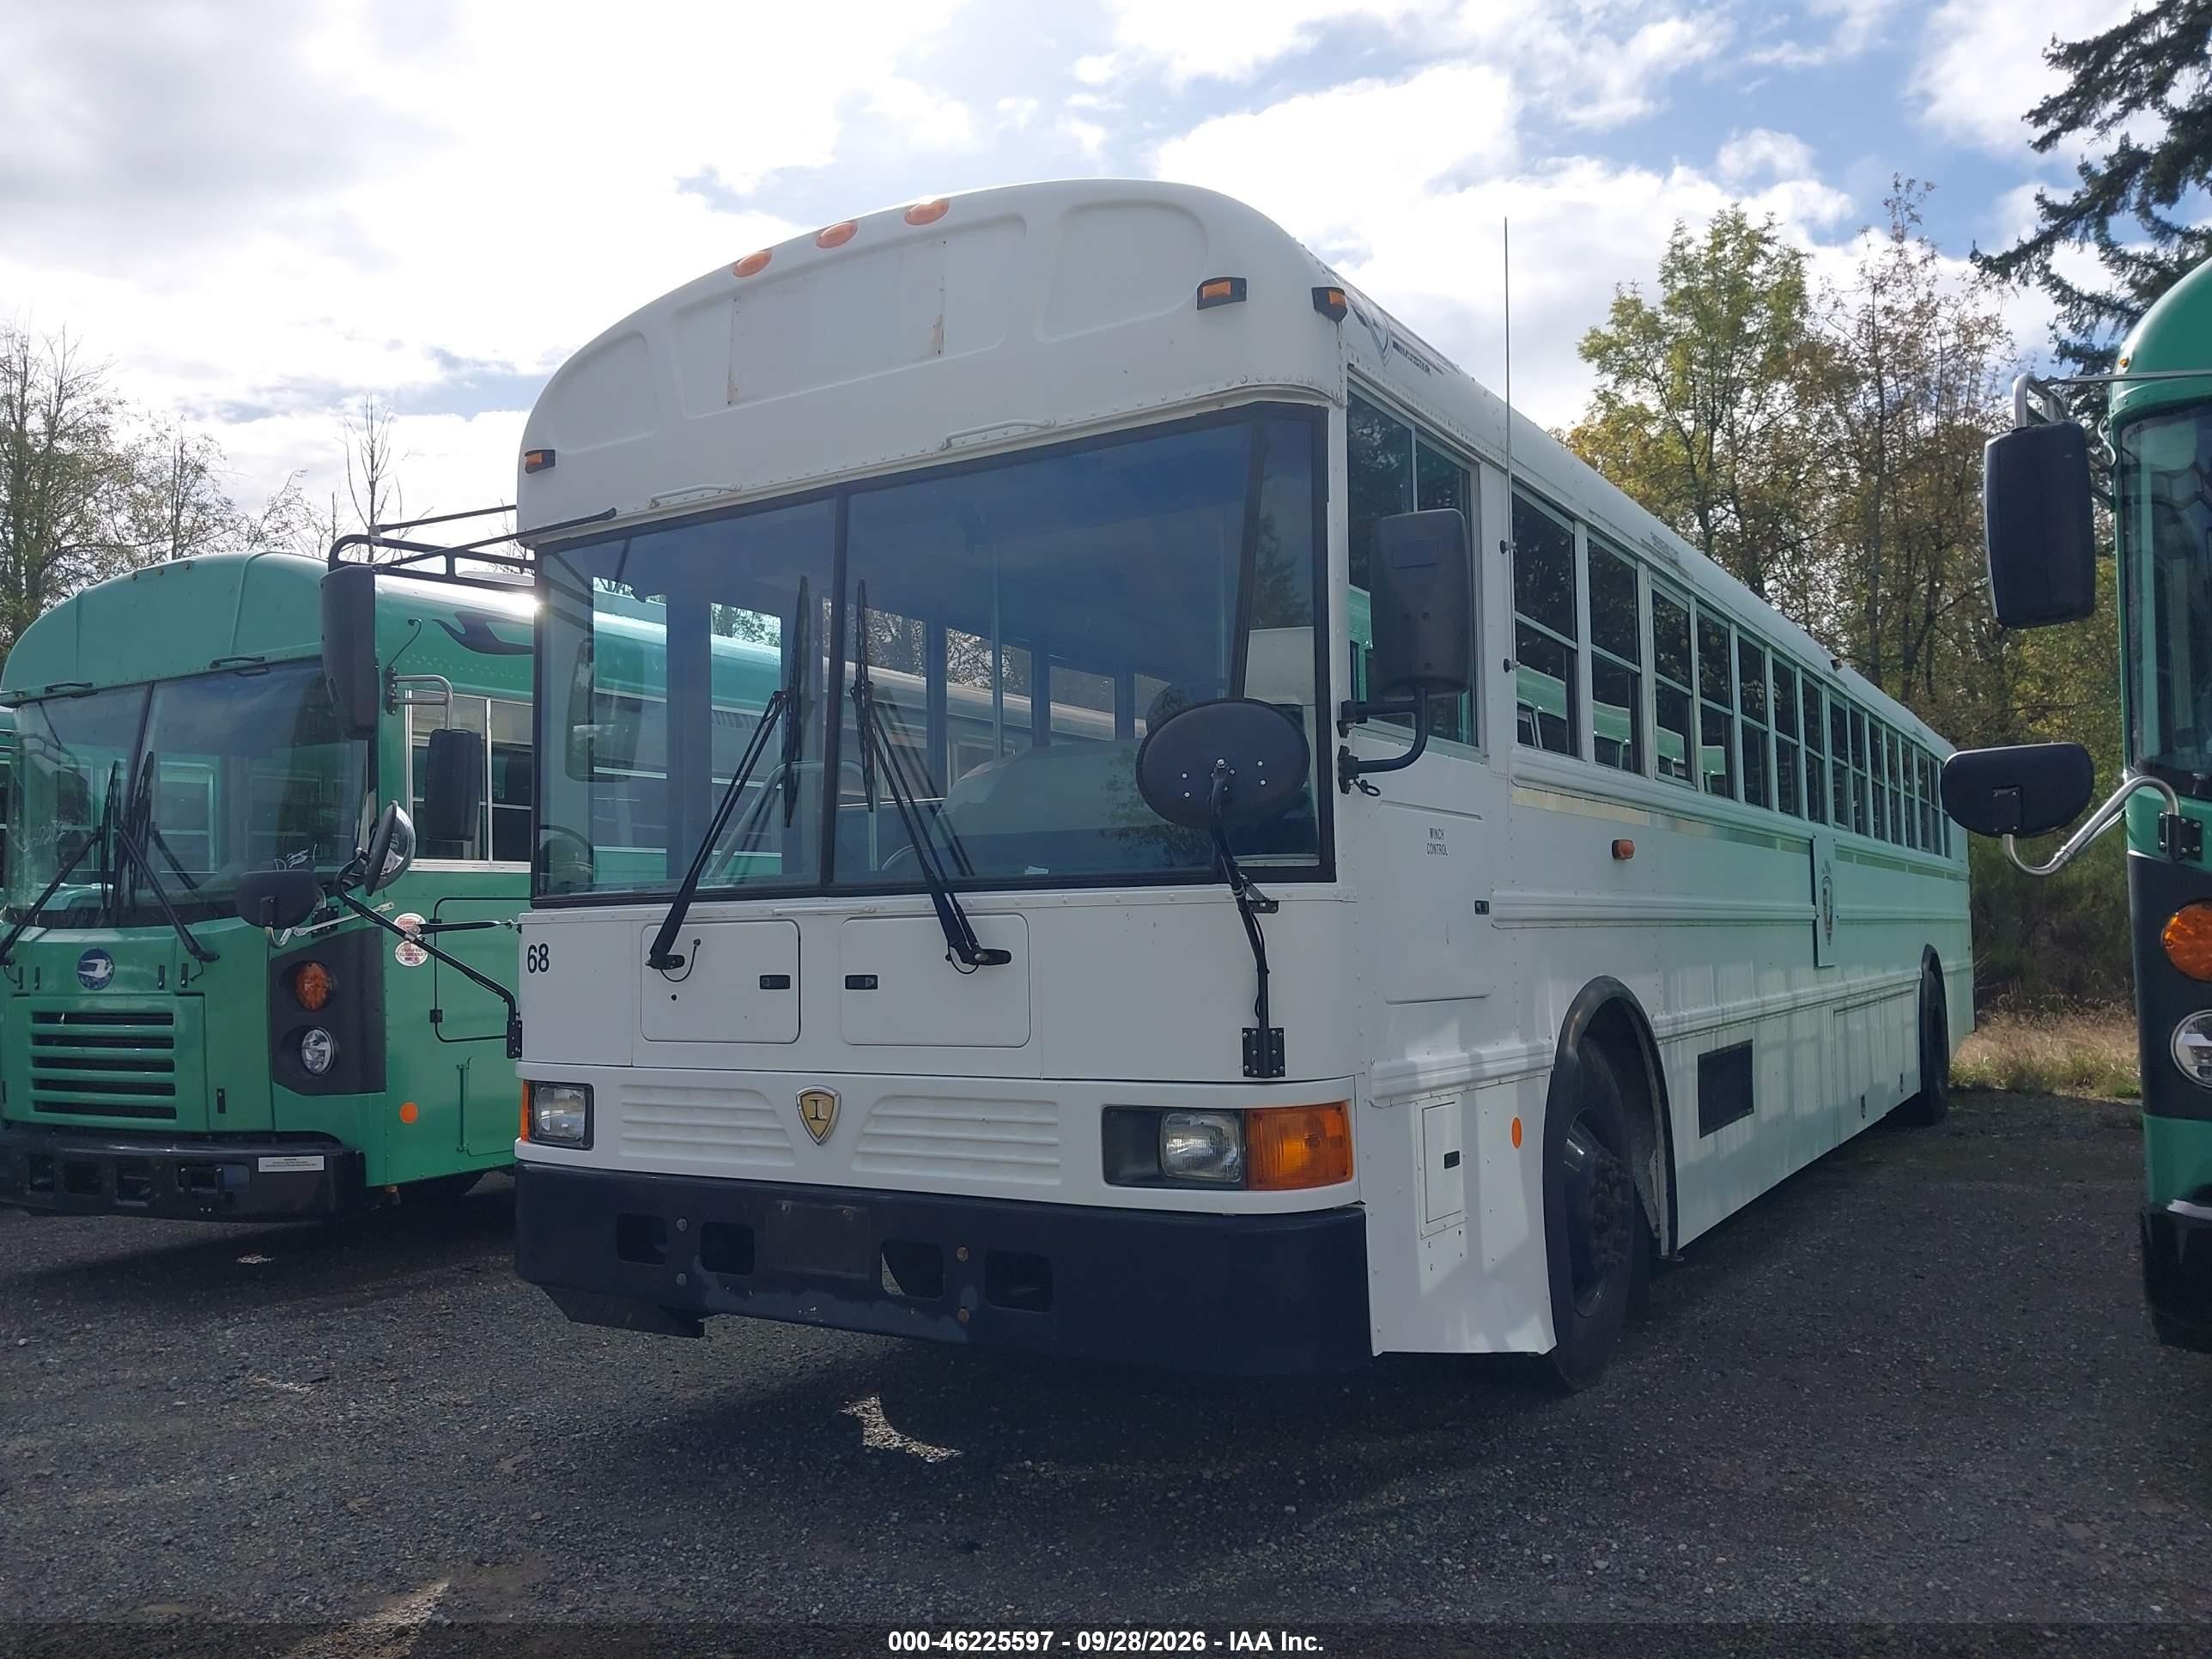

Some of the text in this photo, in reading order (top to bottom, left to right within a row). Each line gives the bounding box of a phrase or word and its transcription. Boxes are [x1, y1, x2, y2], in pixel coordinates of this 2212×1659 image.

[1428, 827, 1444, 841] WINCH
[1426, 842, 1449, 857] CONTROL
[527, 943, 550, 974] 68
